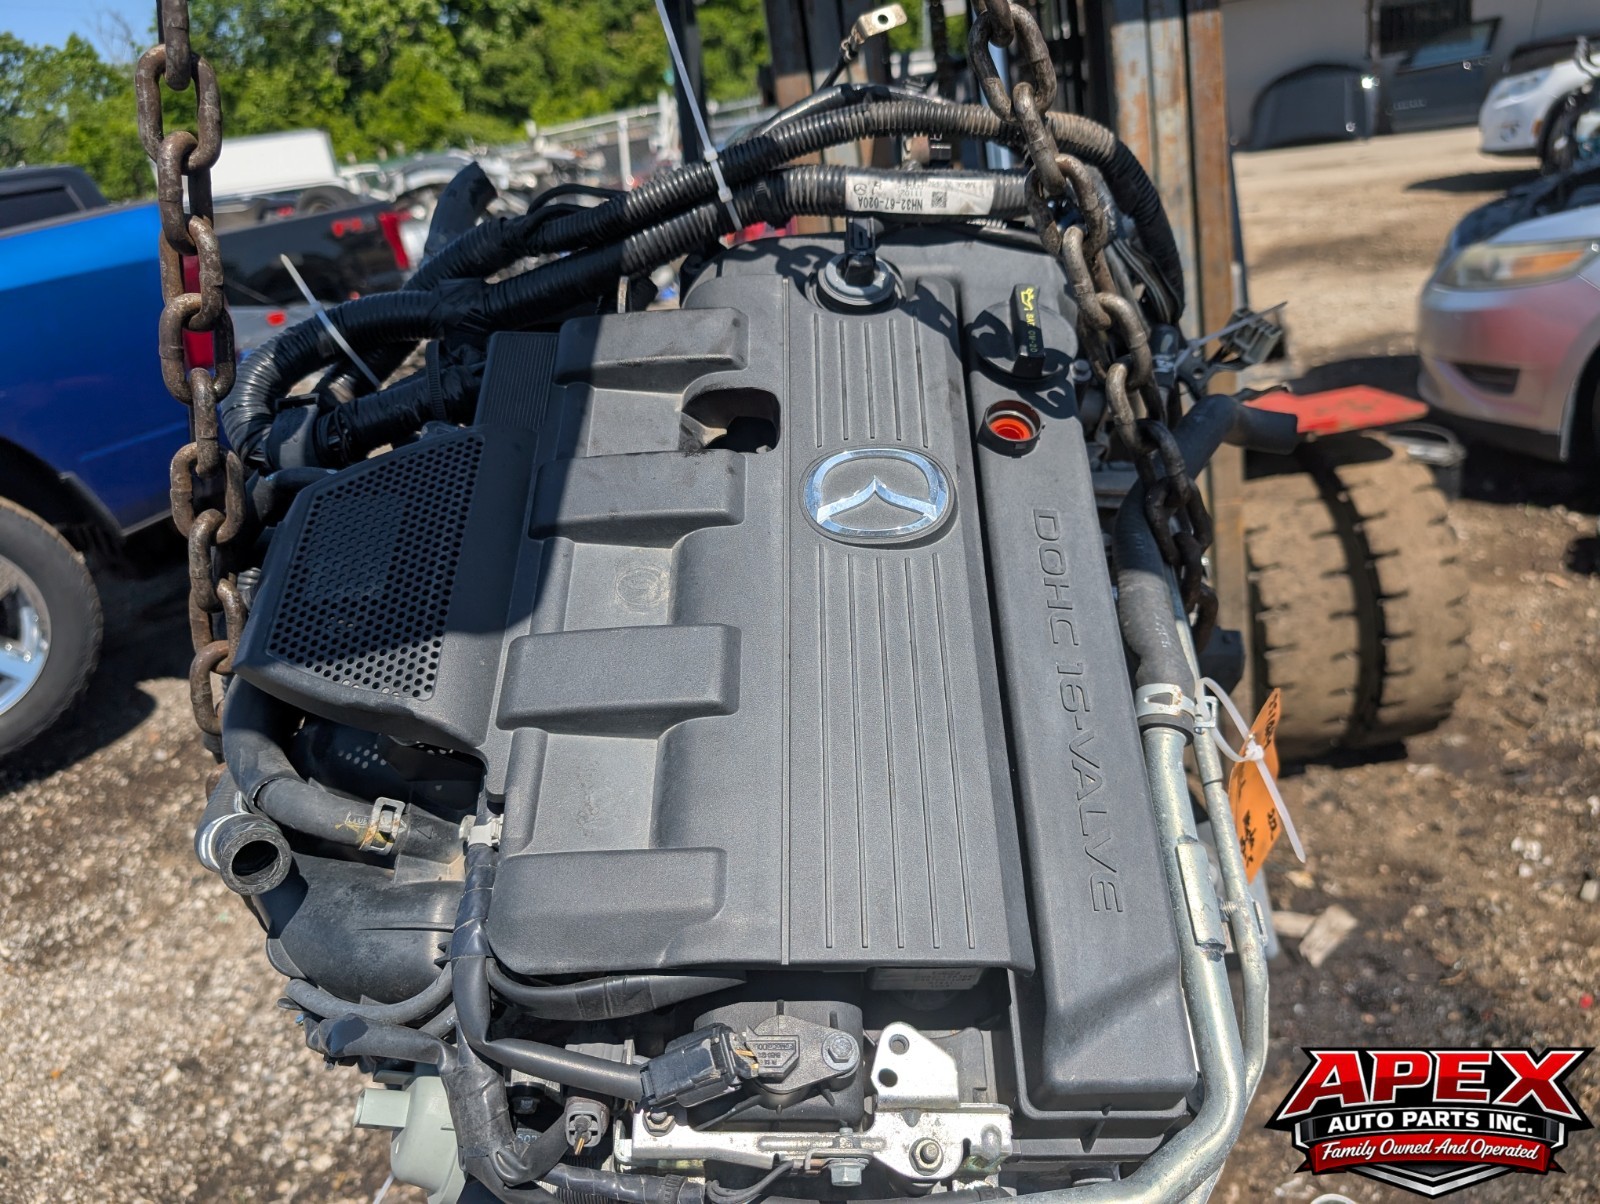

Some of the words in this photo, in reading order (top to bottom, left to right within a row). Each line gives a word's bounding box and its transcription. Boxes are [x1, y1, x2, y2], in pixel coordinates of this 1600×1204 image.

[858, 197, 923, 211] NH32-67-020A
[1032, 509, 1080, 646] DOHC
[1056, 662, 1124, 913] 16-VALVE
